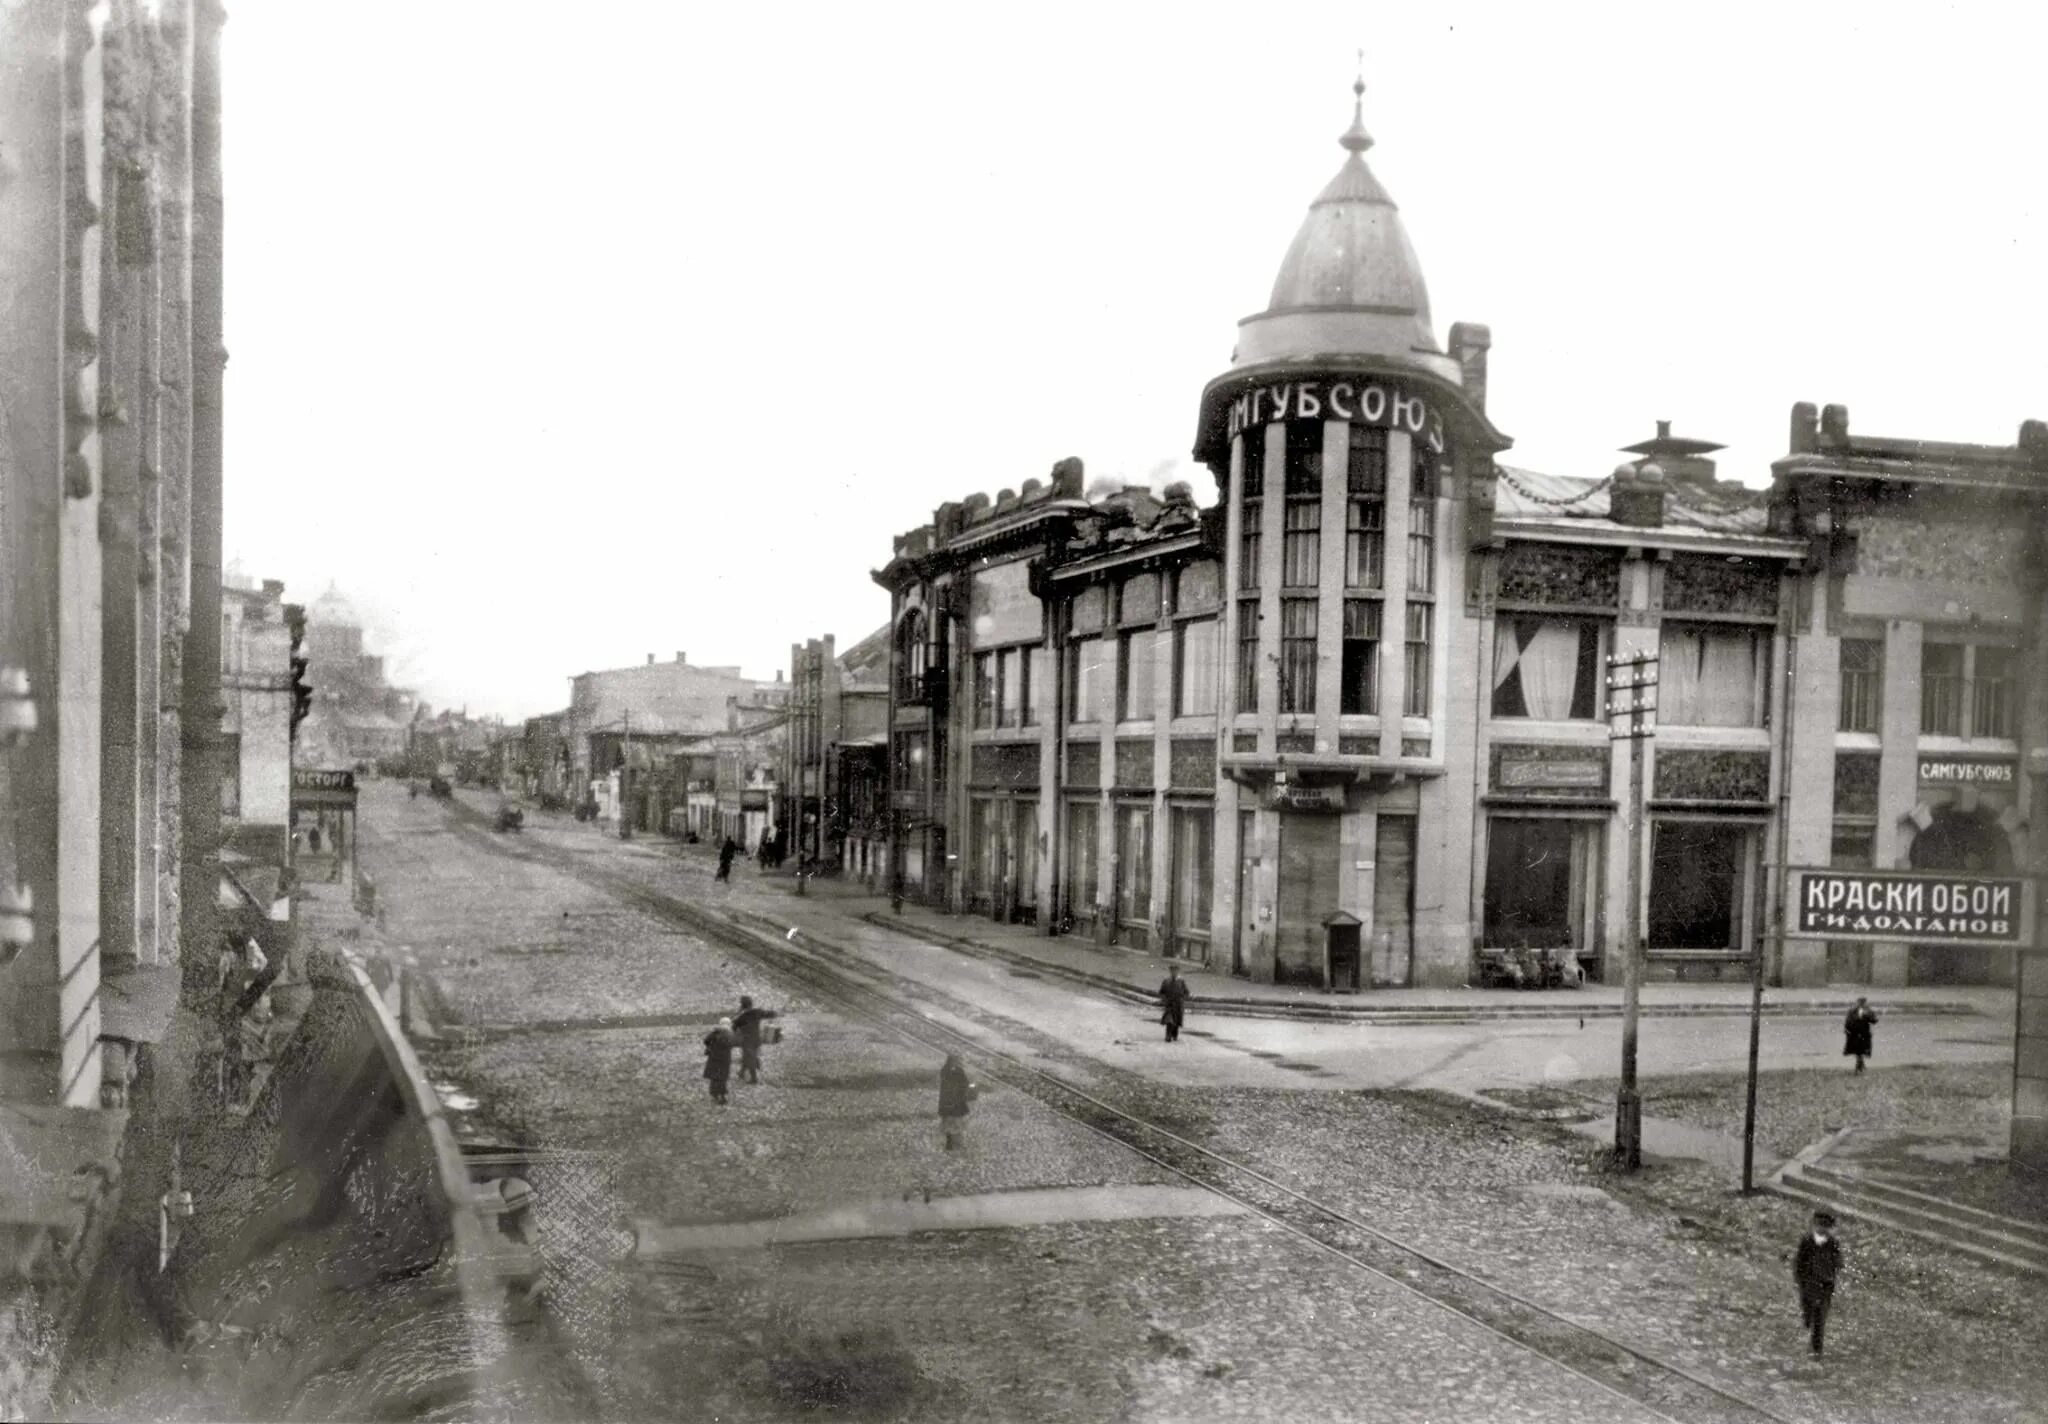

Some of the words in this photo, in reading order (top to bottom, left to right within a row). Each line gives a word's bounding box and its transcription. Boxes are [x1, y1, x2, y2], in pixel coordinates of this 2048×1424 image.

[1920, 763, 2012, 782] САМГУБСОЮЗ
[1808, 879, 1923, 912] КРАСКИ
[1932, 883, 2010, 915] ОБОИ
